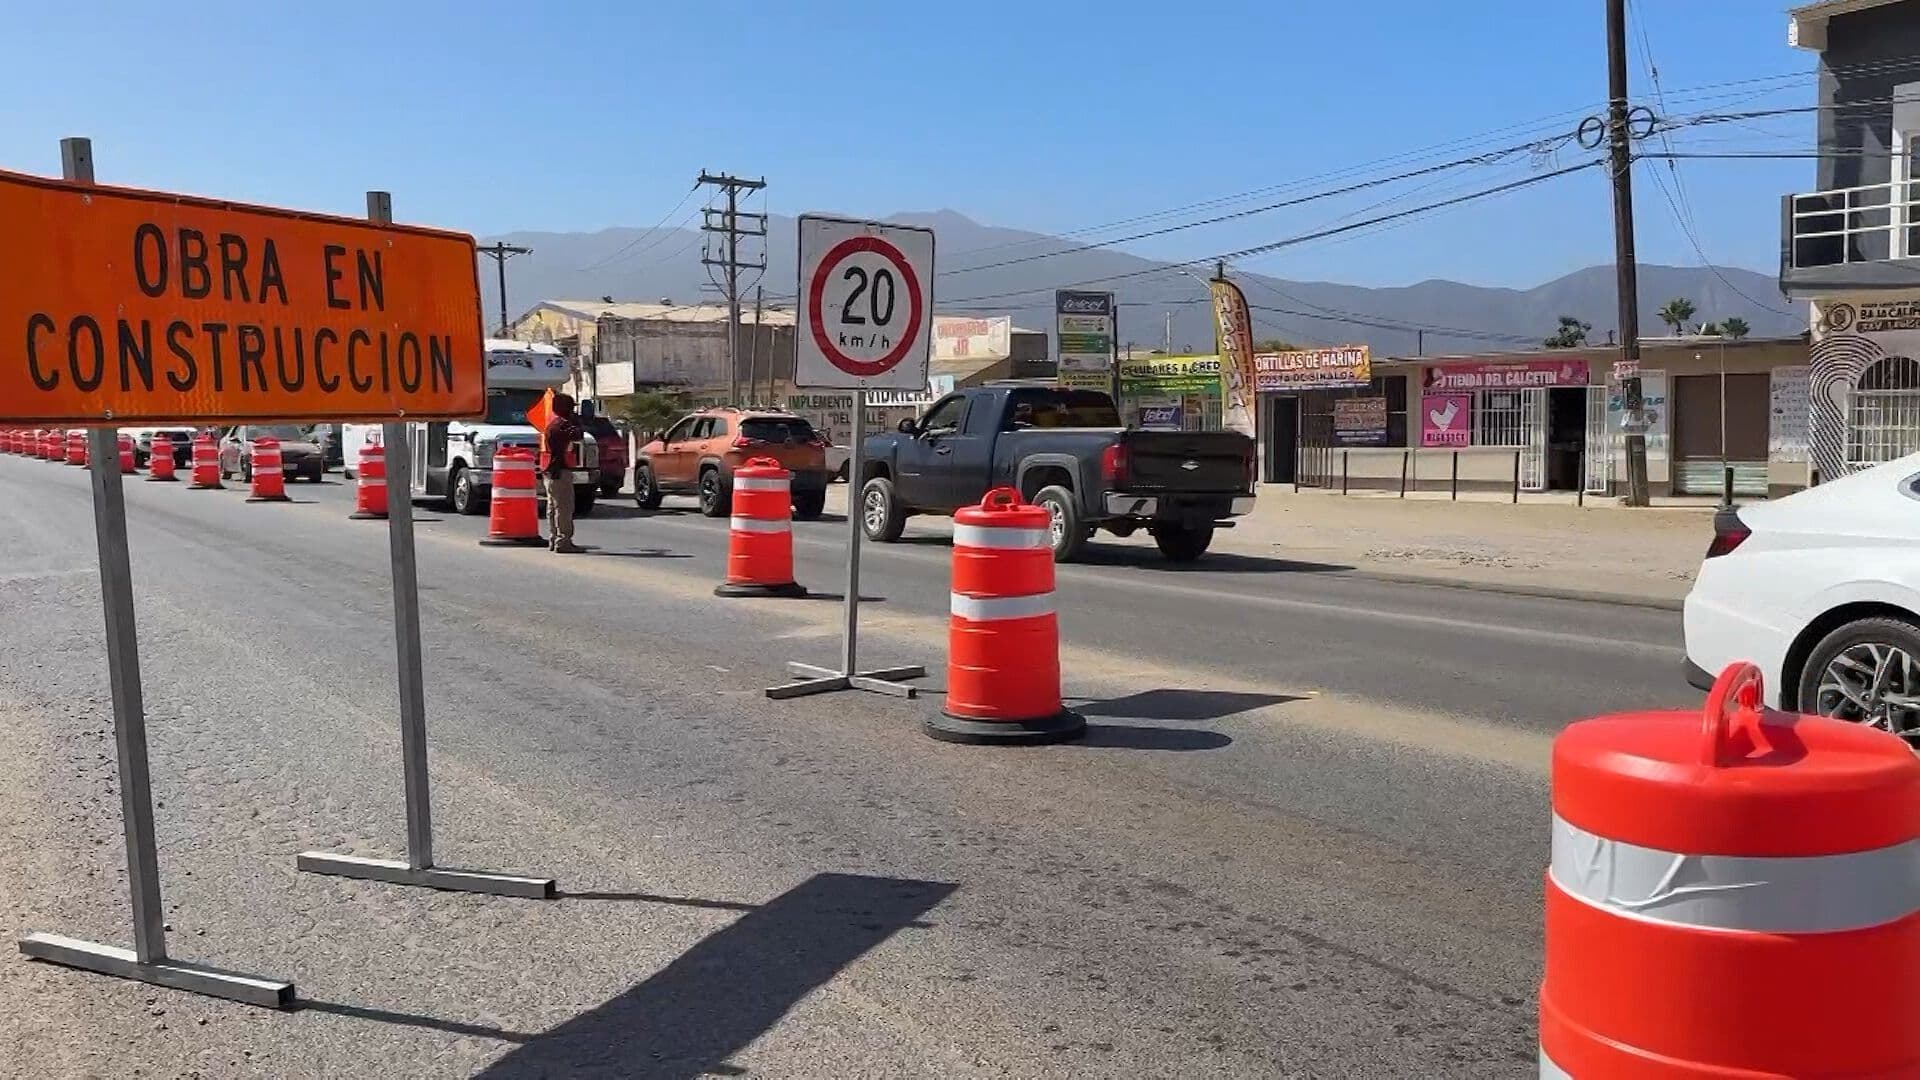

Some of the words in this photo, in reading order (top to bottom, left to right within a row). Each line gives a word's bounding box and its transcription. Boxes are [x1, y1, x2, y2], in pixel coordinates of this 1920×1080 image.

[133, 223, 289, 304] OBRA
[323, 245, 385, 312] EN
[841, 266, 894, 326] 20
[26, 313, 454, 393] CONSTRUCCION
[1189, 361, 1220, 373] CRED
[1255, 353, 1304, 371] ORTILLAS
[1305, 353, 1319, 368] DE
[1321, 350, 1363, 366] HARINA
[1447, 374, 1482, 387] TIENDA
[1485, 373, 1503, 386] DEL
